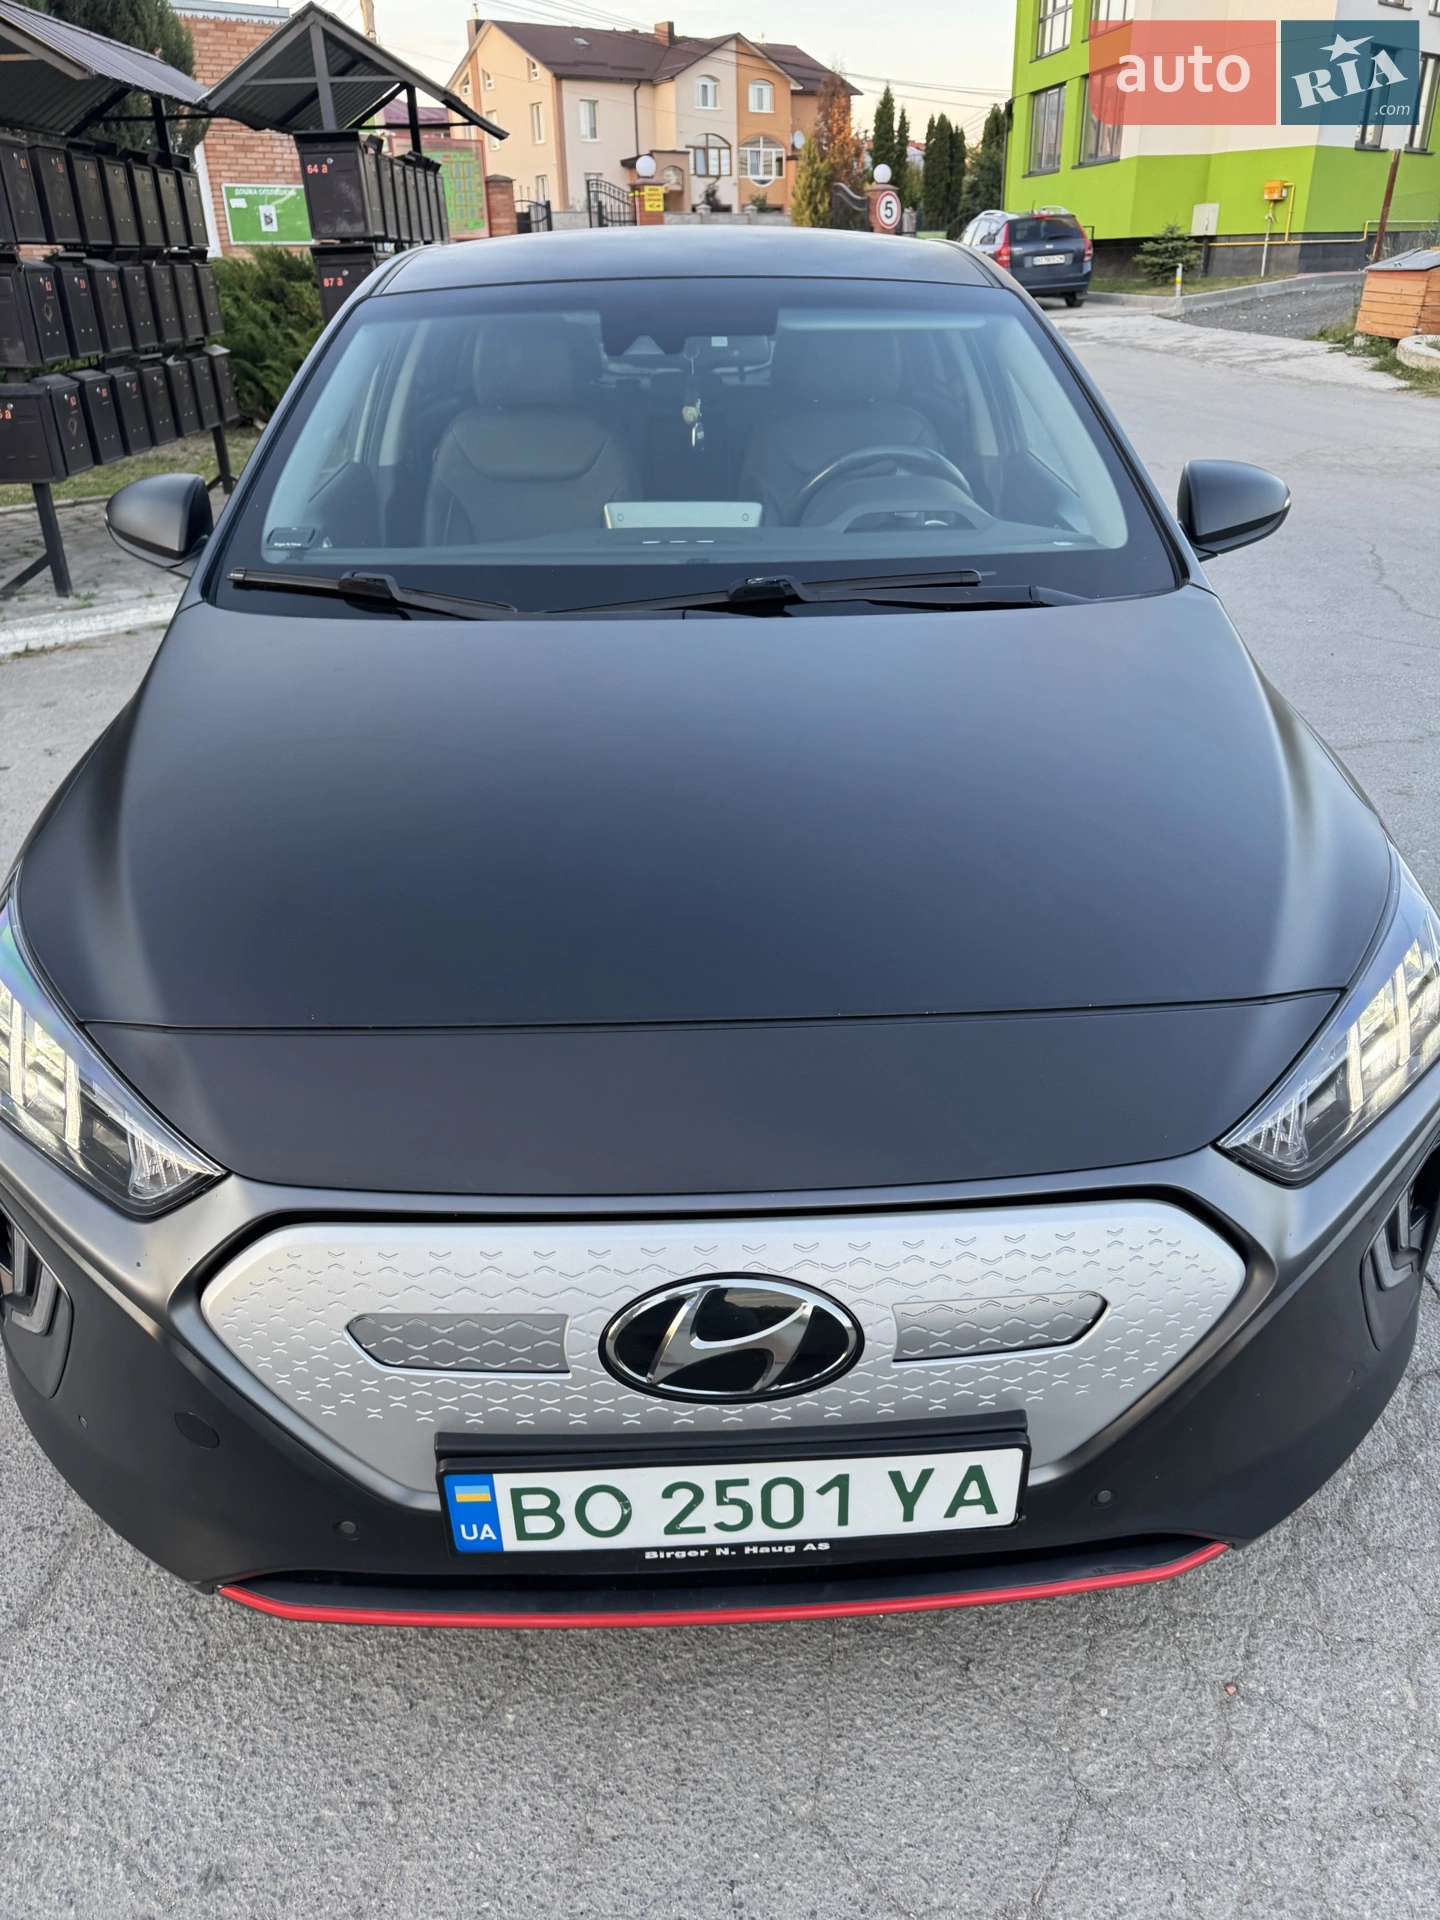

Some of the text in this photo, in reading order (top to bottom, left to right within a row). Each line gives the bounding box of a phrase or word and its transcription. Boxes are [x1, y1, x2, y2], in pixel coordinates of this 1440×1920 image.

[306, 163, 319, 175] 64
[884, 200, 893, 219] 5
[510, 1464, 999, 1541] BO 2501 YA
[460, 1523, 497, 1541] UA
[644, 1542, 831, 1560] Birger N. Haug AS
